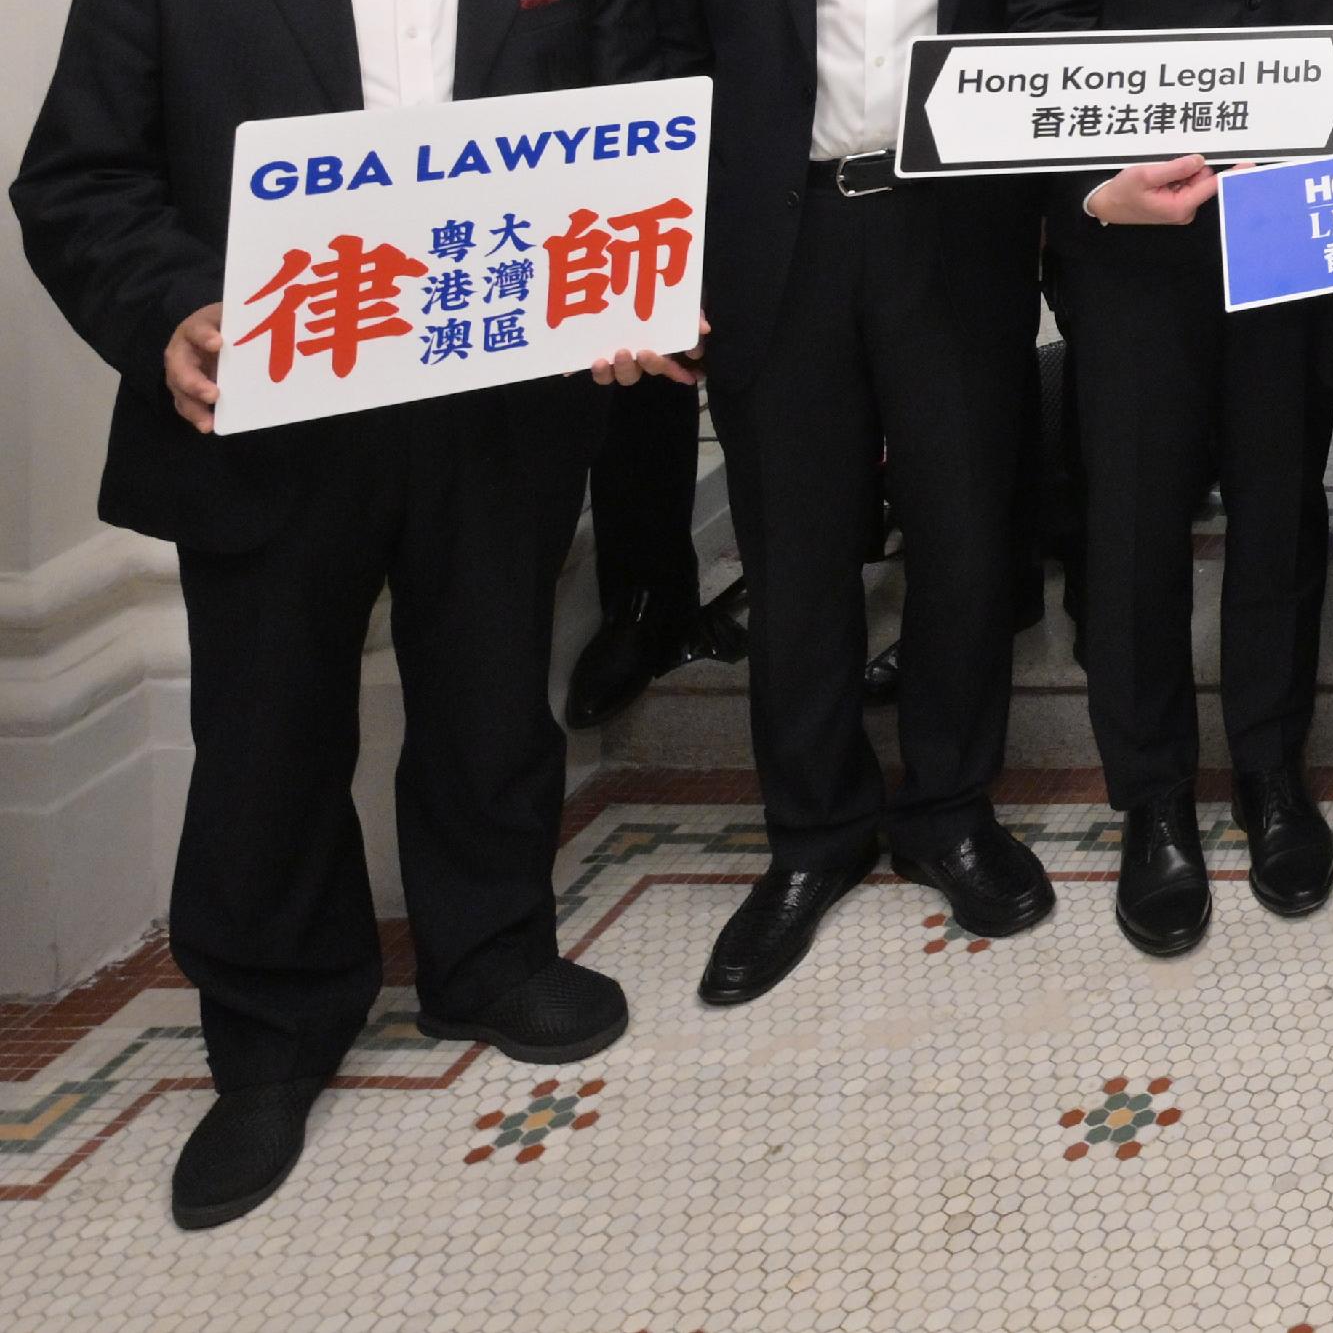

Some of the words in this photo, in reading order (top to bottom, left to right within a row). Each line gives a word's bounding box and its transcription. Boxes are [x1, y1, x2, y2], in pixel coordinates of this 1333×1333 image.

[957, 69, 1049, 98] Hong
[1061, 66, 1146, 95] Kong
[1159, 61, 1246, 93] Legal
[1256, 59, 1322, 85] Hub
[1030, 100, 1250, 139] 香港法律樞紐
[250, 151, 393, 201] GBA
[416, 115, 697, 183] LAWYERS
[233, 234, 429, 384] 律
[420, 219, 477, 366] 粵港澳
[482, 212, 537, 354] 大灣區
[542, 197, 694, 330] 師
